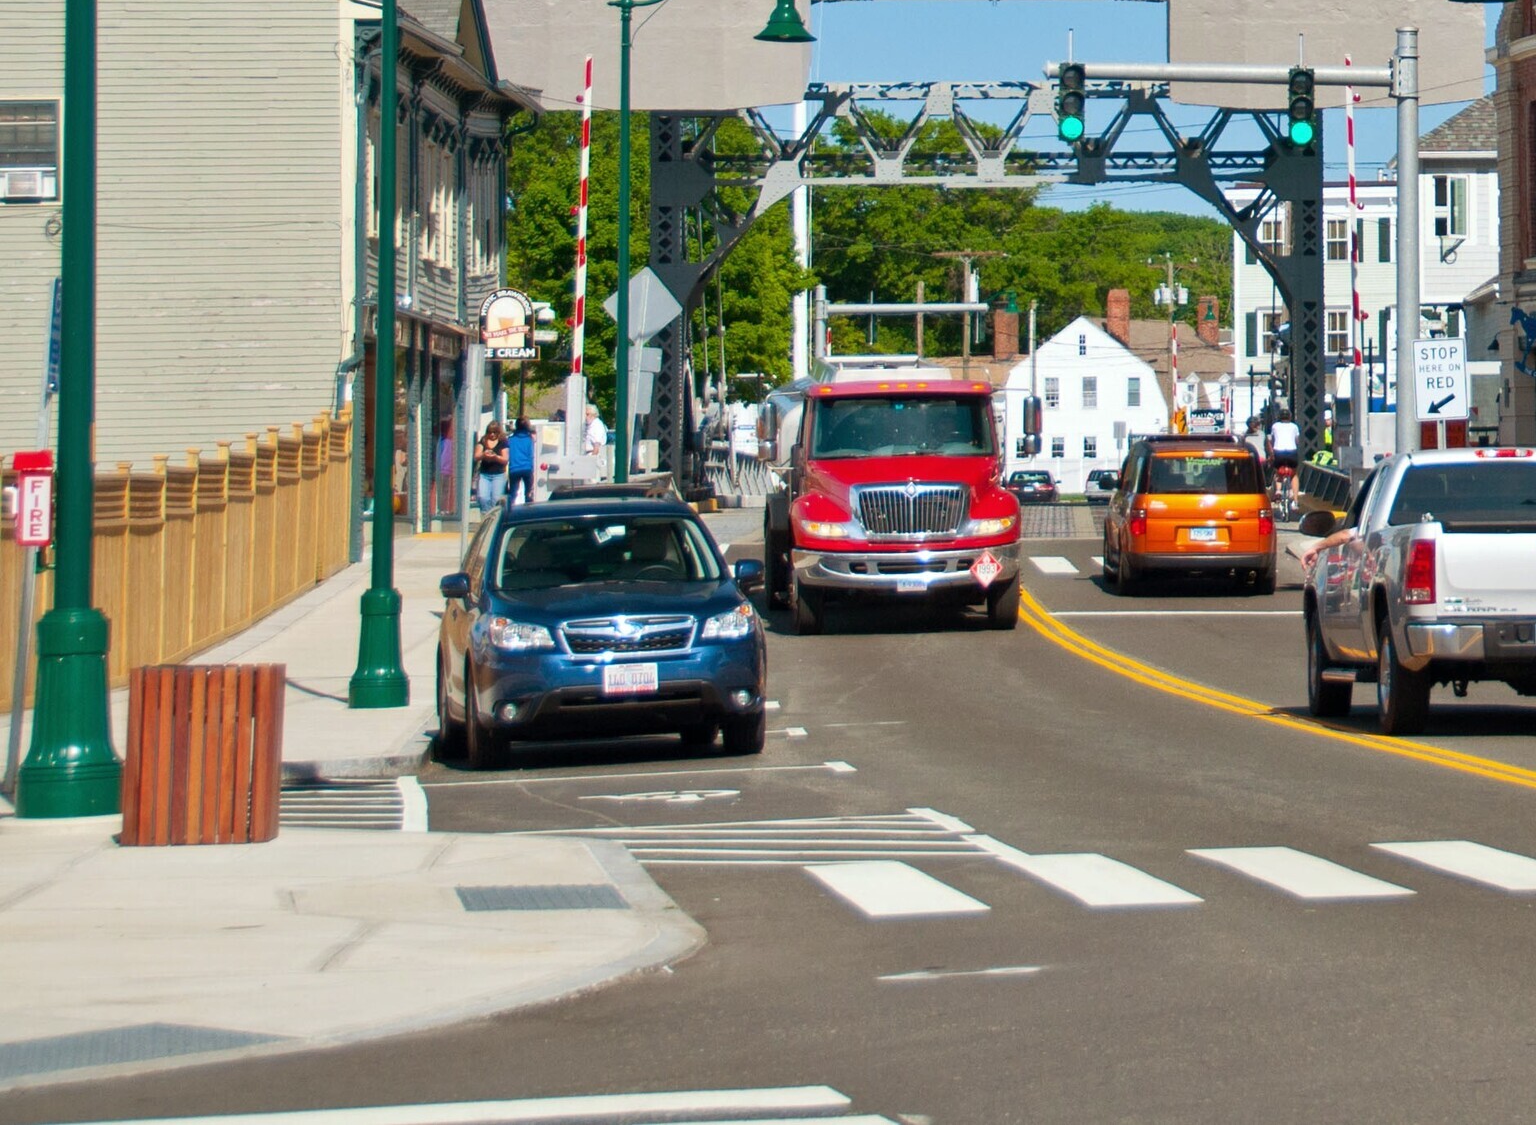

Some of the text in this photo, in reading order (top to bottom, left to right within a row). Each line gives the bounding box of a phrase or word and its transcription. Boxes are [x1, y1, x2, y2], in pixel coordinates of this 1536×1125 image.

[497, 347, 536, 358] CREAM
[1420, 346, 1458, 361] STOP
[1419, 363, 1461, 373] HERE ON
[1426, 376, 1455, 389] RED
[29, 480, 44, 537] FIRE
[980, 565, 997, 574] 1993
